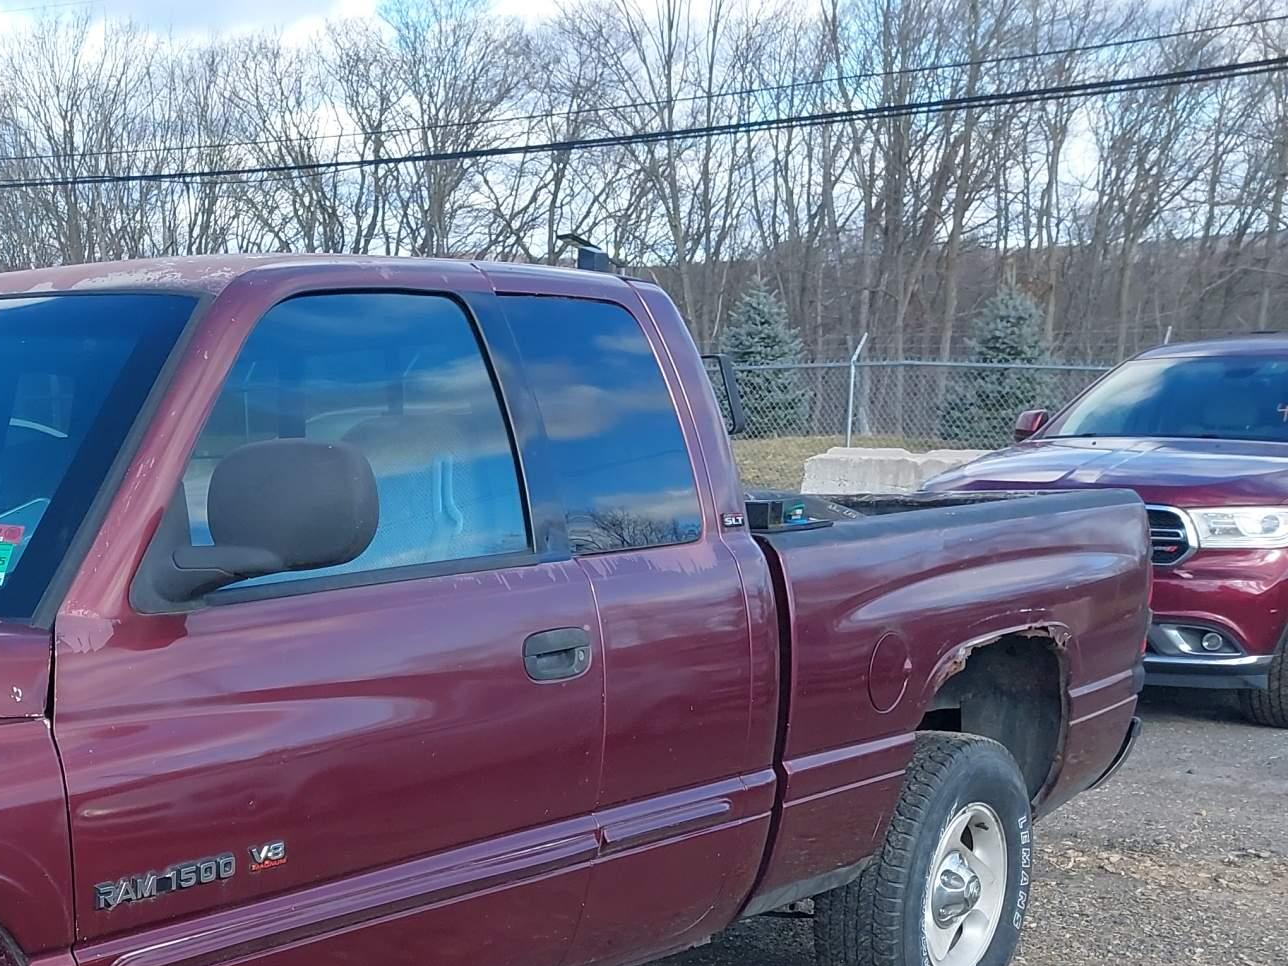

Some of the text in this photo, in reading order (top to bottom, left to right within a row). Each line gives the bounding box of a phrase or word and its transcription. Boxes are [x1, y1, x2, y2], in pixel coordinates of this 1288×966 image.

[723, 516, 744, 526] SLT
[250, 841, 286, 864] V8
[96, 854, 236, 910] RAM 1500
[1012, 815, 1033, 930] LEMANS
